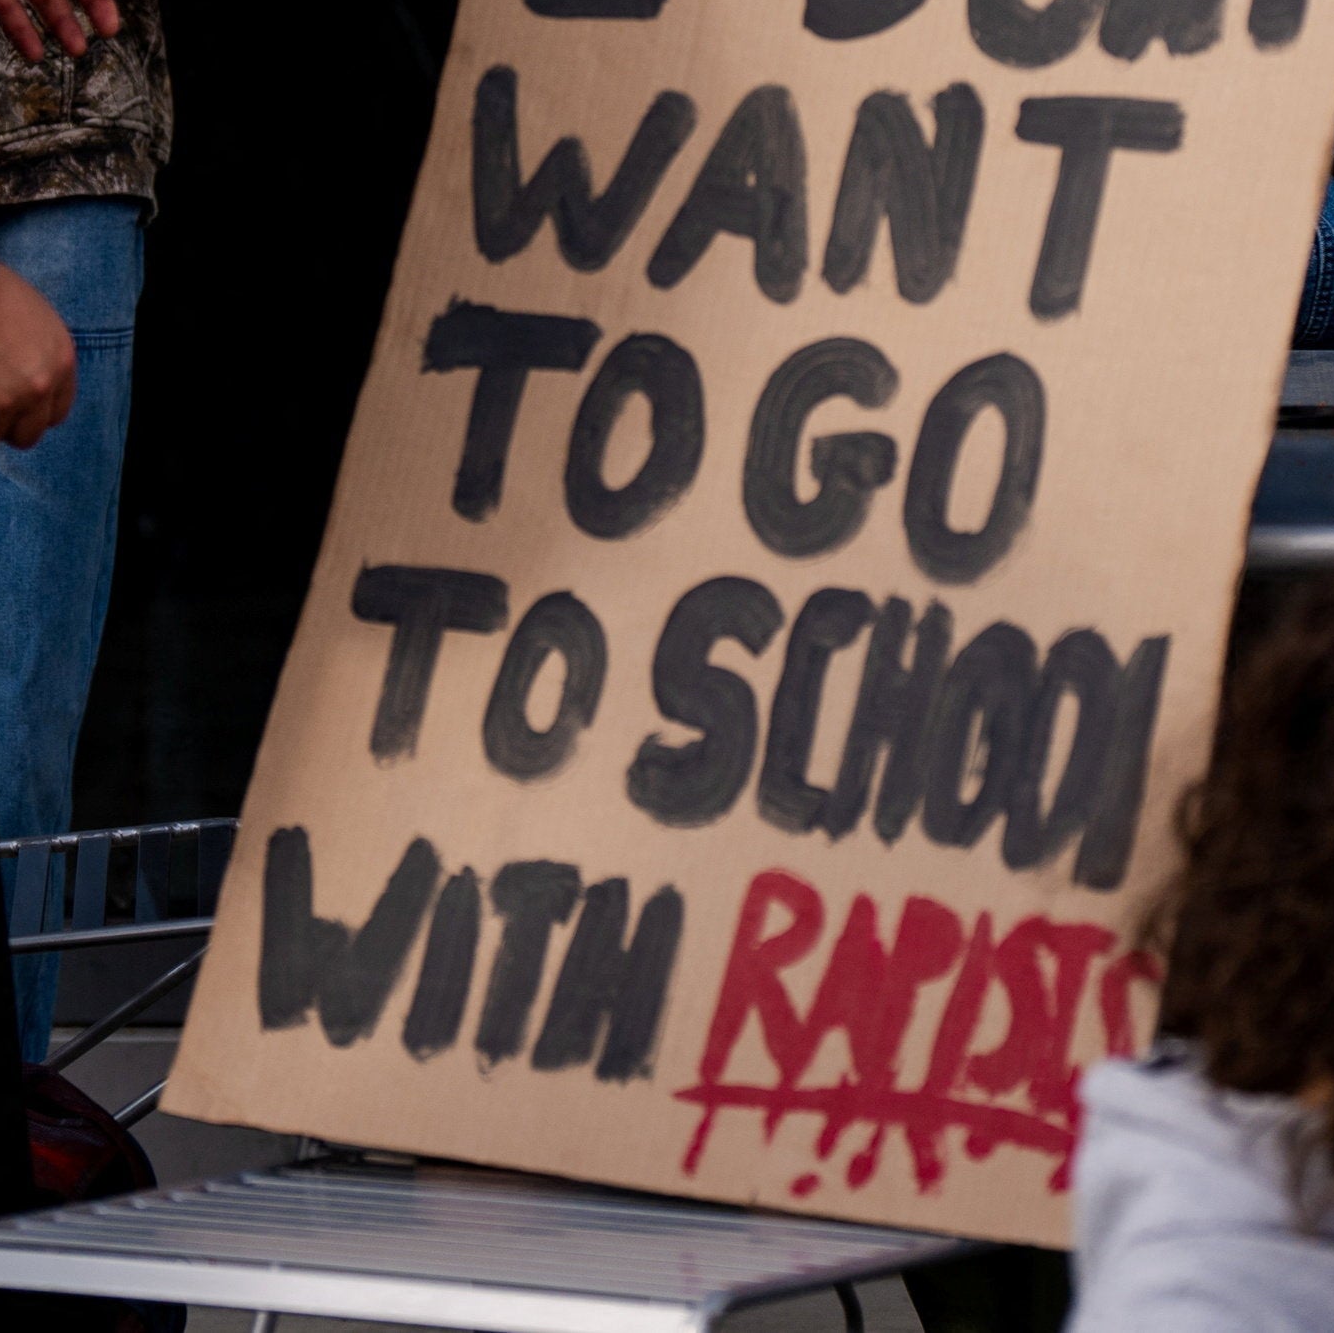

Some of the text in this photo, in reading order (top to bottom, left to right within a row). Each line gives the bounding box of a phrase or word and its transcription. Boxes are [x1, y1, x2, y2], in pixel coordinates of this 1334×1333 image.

[471, 65, 1184, 319] WANT
[421, 298, 1046, 584] TO GO
[353, 564, 1171, 893] TO SCHOOL
[258, 826, 684, 1079] WITH
